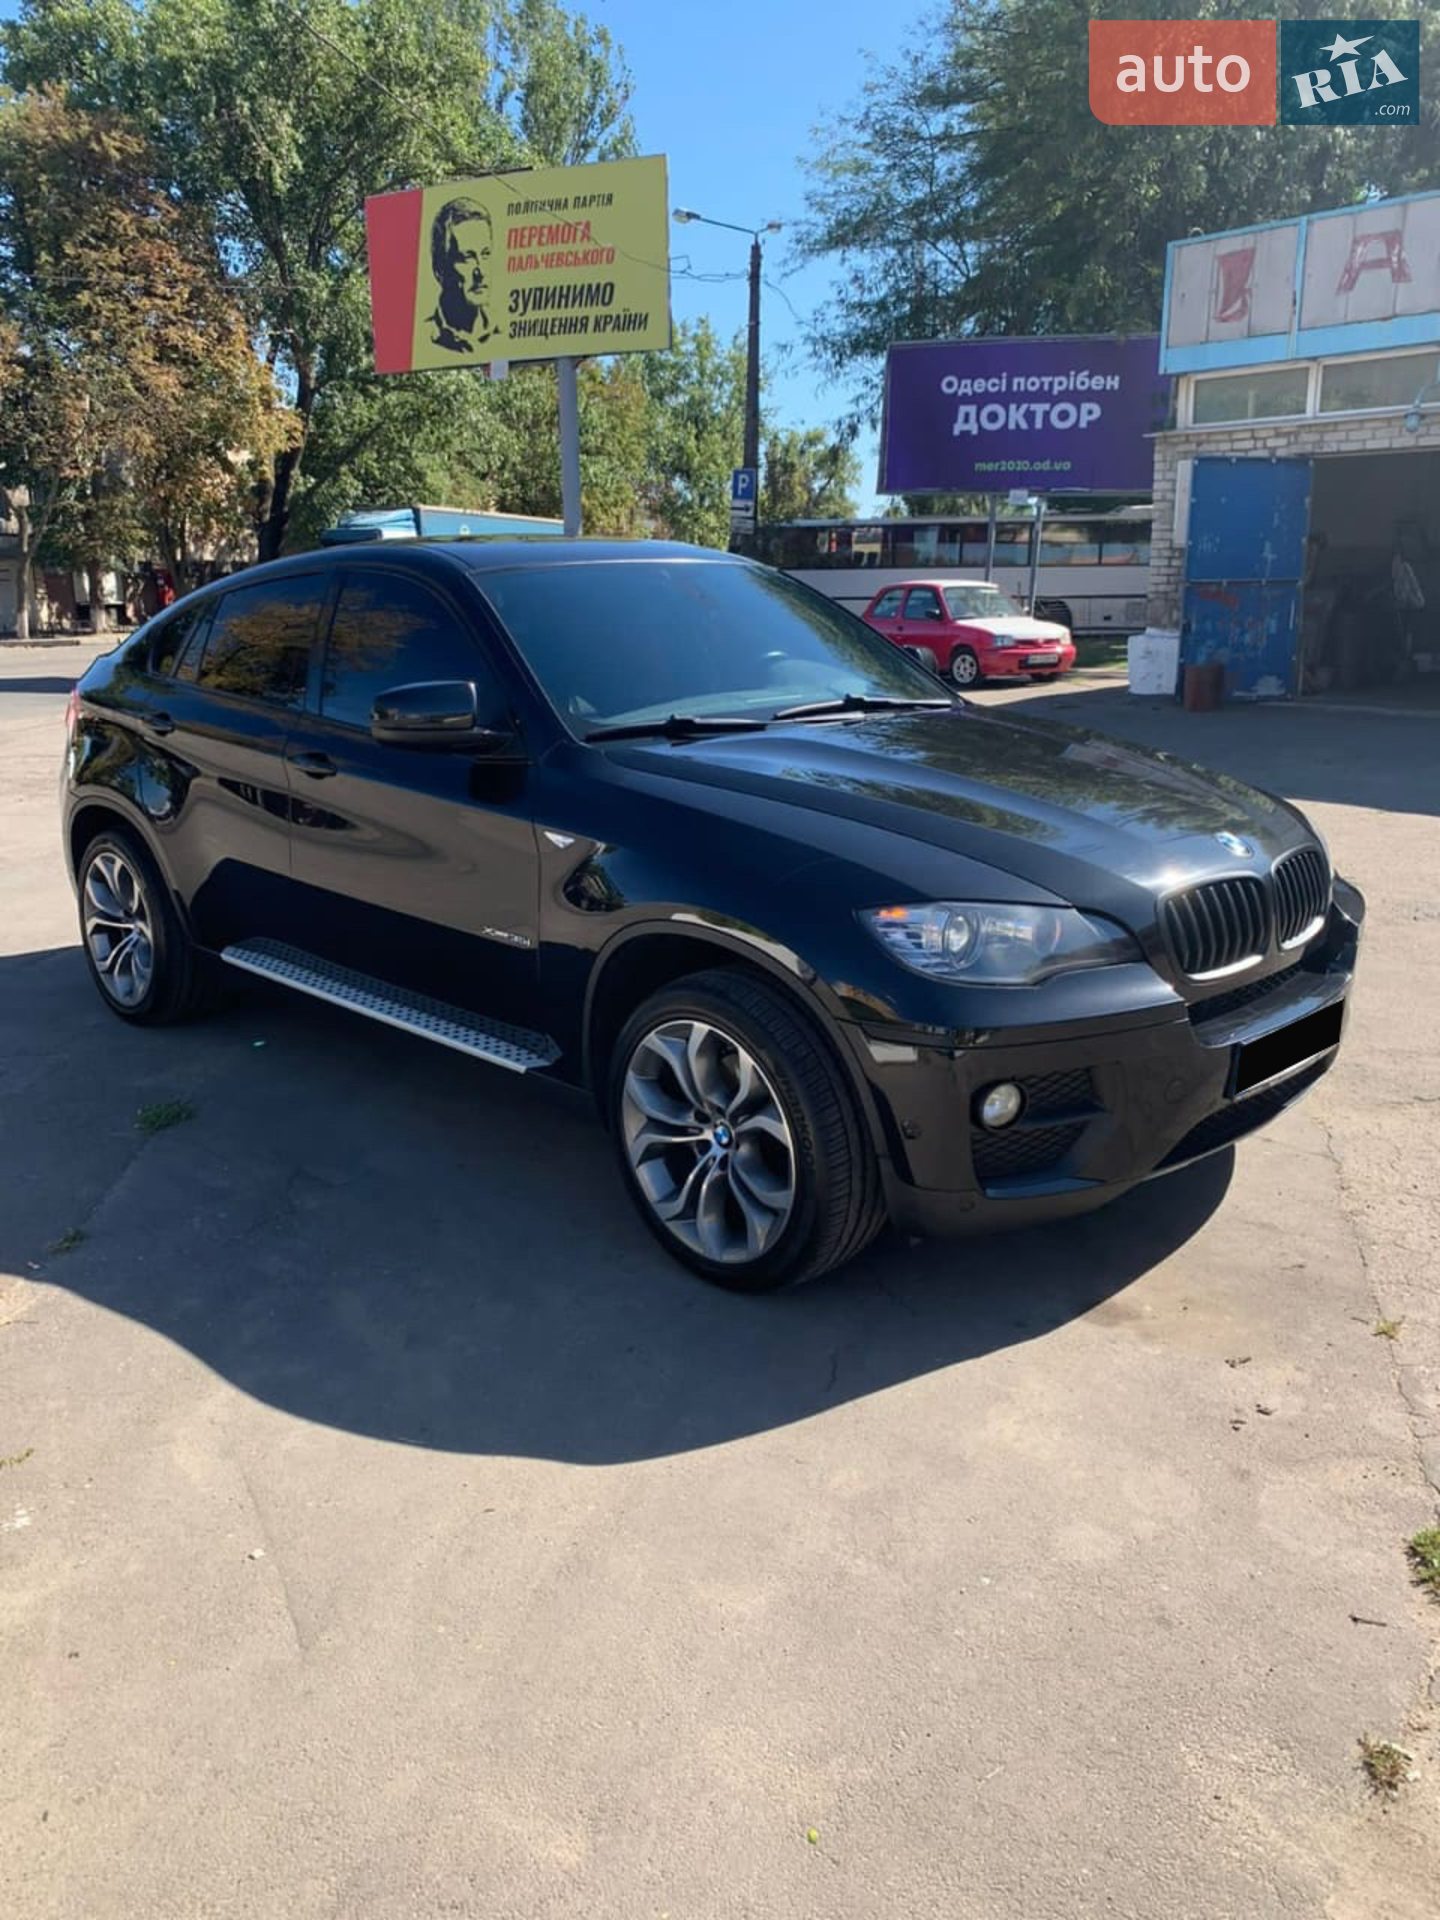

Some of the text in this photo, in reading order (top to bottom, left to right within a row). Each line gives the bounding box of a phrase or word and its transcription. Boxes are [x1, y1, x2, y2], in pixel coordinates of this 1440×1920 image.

[573, 193, 613, 210] ПАРТІЯ
[507, 220, 591, 250] ПЕРЕМОГА
[507, 247, 615, 273] ПАЛЬЧЕВСЬКОГО
[508, 281, 615, 317] ЗУПИНИМО
[508, 307, 649, 340] ЗНИЩЕННЯ КРАЇНИ
[941, 370, 1120, 396] Одесі потрібен
[953, 402, 1101, 436] ДОКТОР
